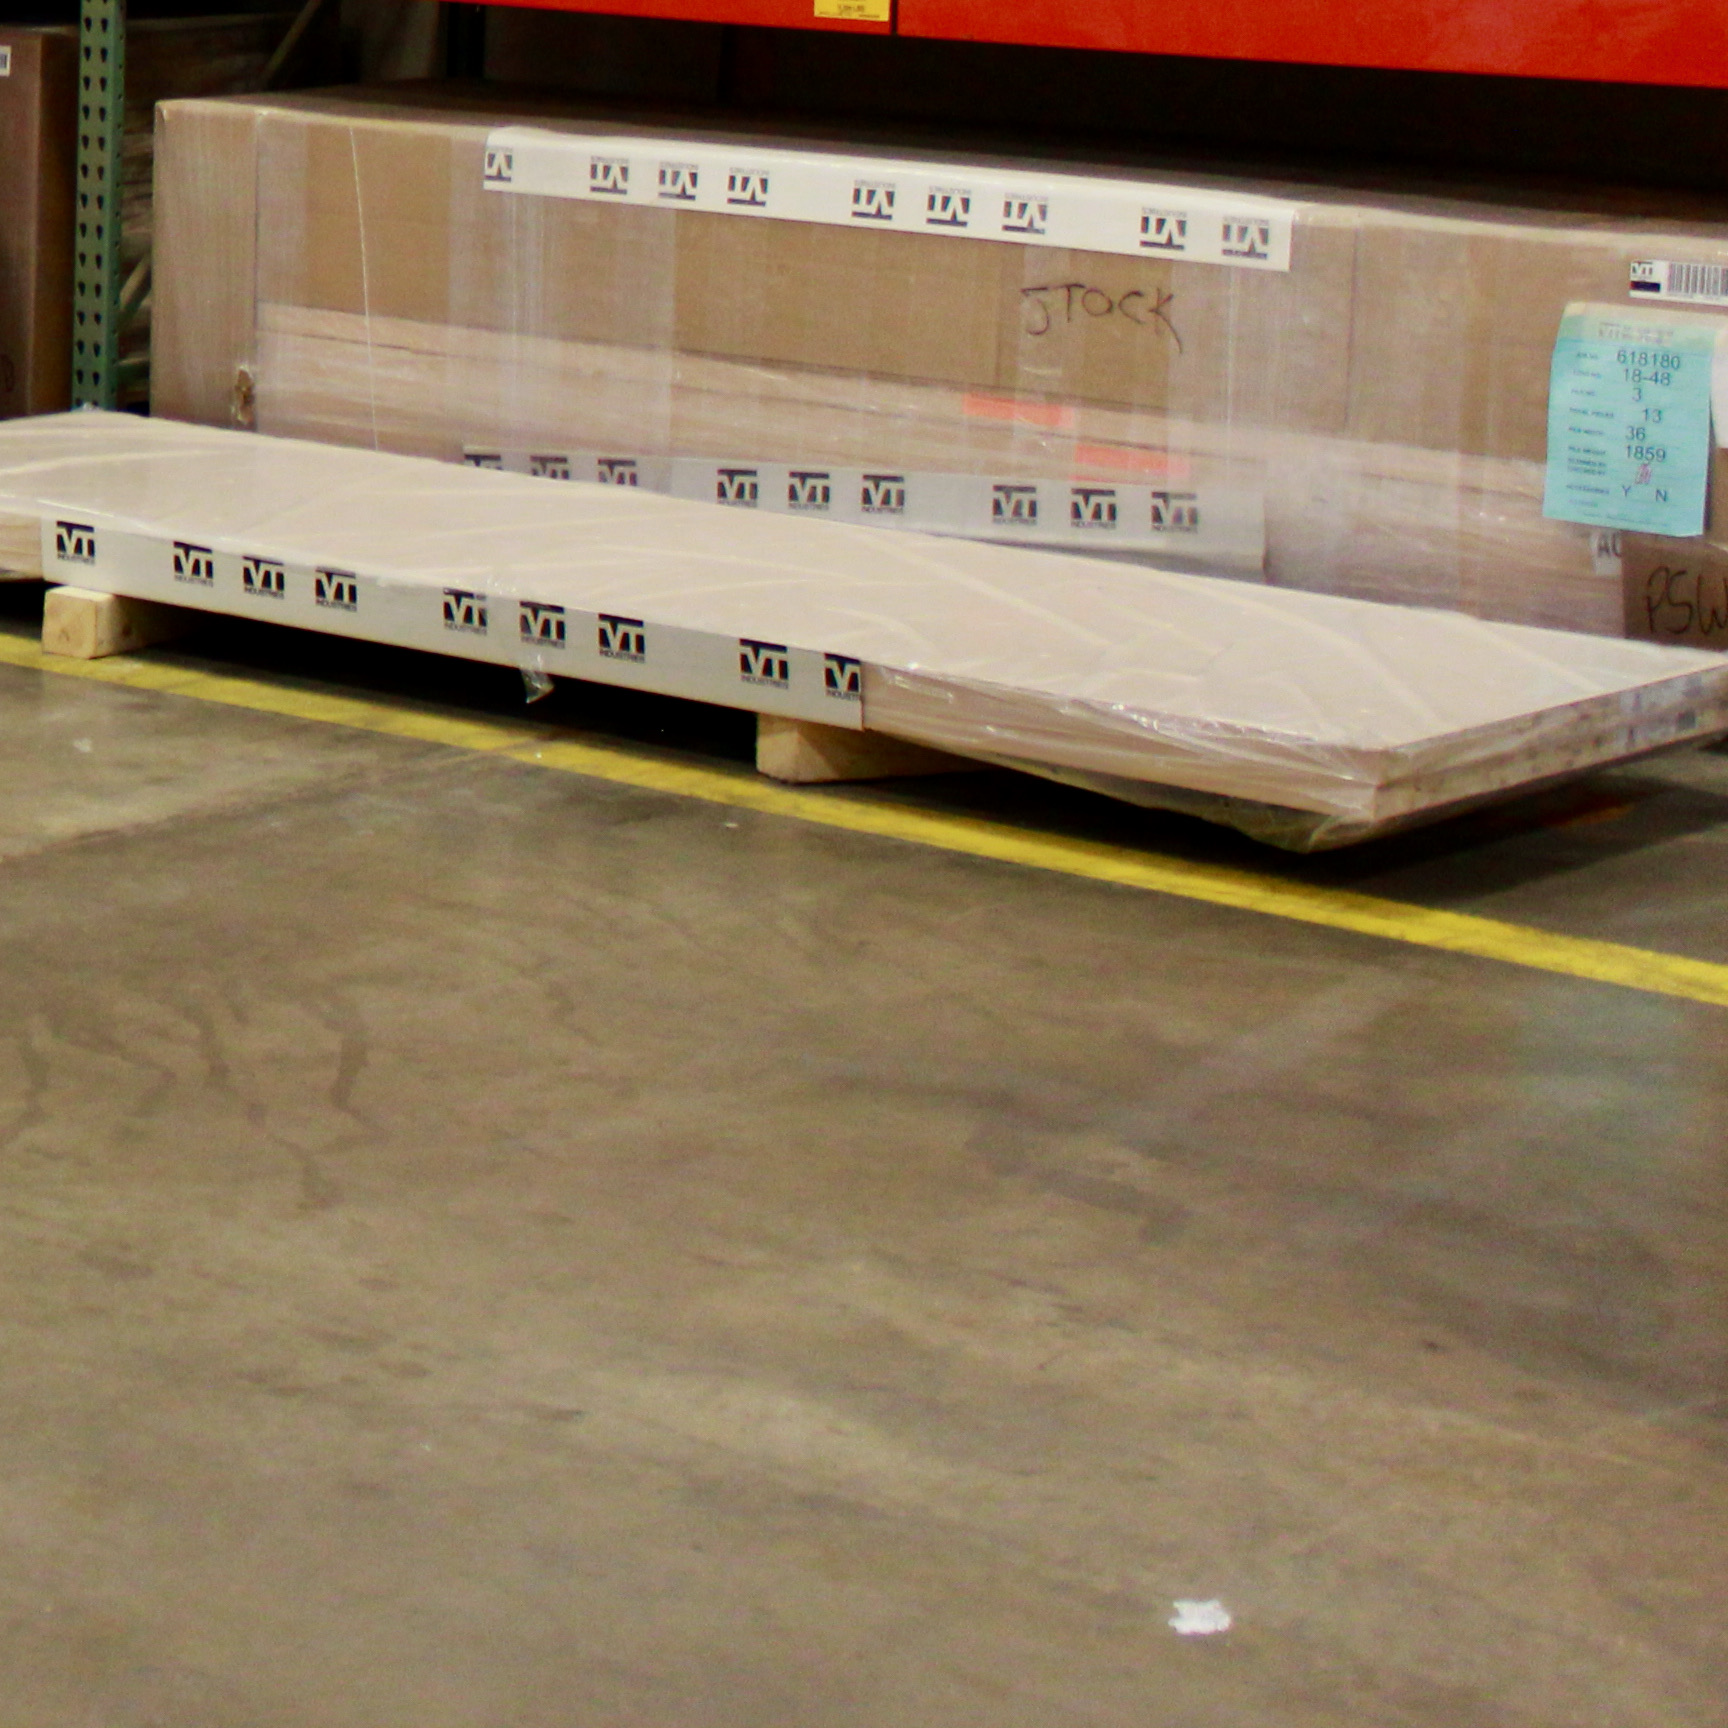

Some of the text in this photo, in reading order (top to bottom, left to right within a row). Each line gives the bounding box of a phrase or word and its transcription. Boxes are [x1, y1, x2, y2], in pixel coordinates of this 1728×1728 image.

[1616, 348, 1681, 371] 618180
[1624, 368, 1671, 387] 18-48
[1632, 387, 1643, 403] 3
[1642, 407, 1662, 424] 13
[1625, 425, 1646, 442] 36
[1625, 445, 1667, 463] 1859
[717, 469, 1198, 526] VT VT VT VT VT VT
[1621, 485, 1668, 503] Y N
[57, 521, 95, 557] VT
[173, 540, 214, 580] VT
[242, 555, 284, 592] VT
[315, 566, 356, 605] VT
[443, 588, 487, 628] VT
[519, 601, 565, 640] VT
[598, 612, 645, 654] VT
[740, 638, 789, 680] VT
